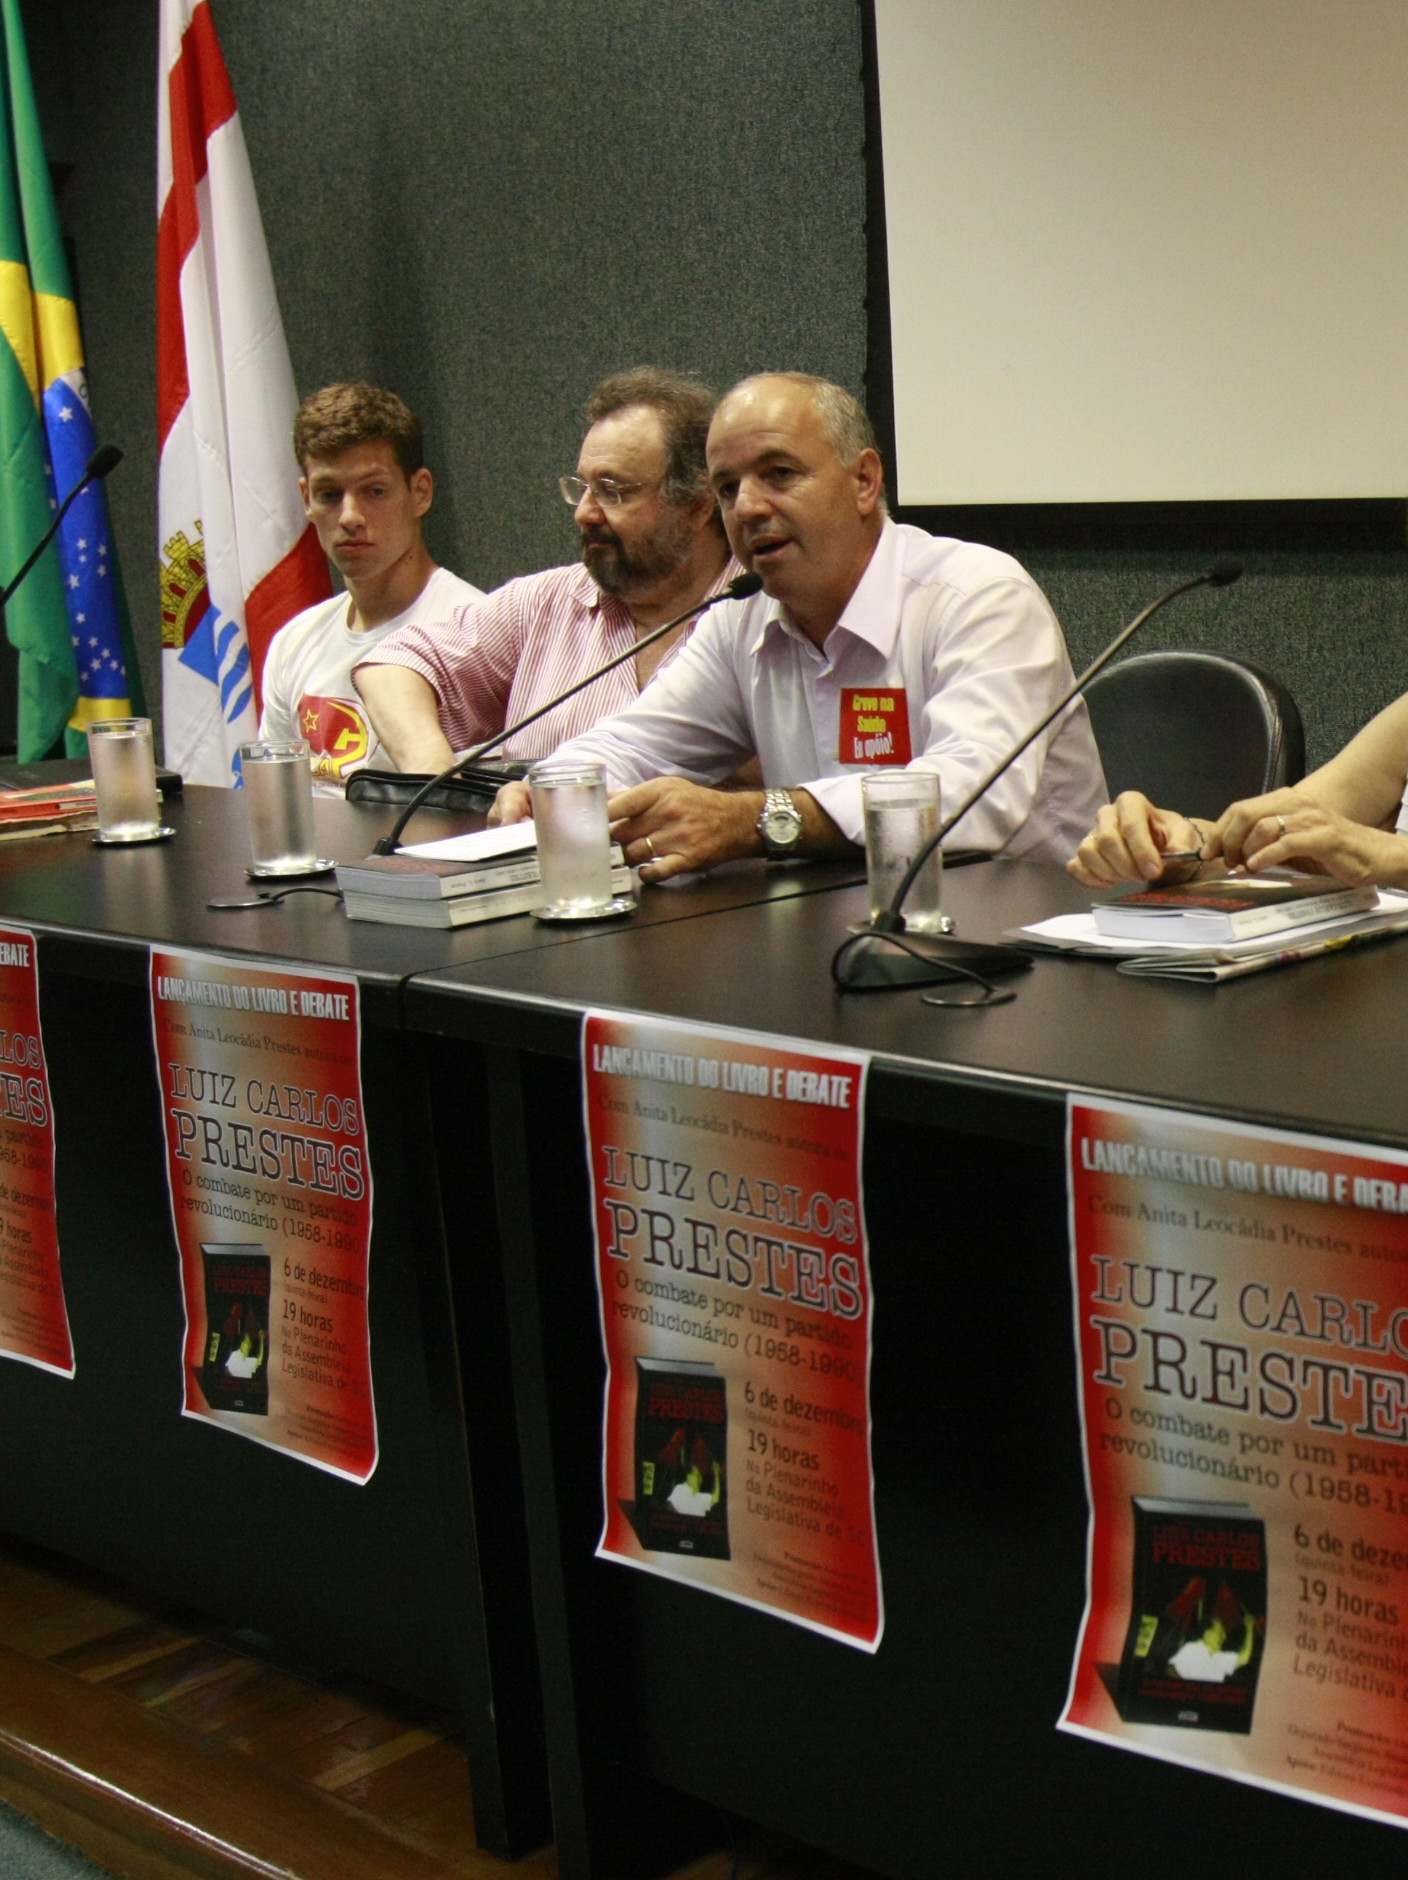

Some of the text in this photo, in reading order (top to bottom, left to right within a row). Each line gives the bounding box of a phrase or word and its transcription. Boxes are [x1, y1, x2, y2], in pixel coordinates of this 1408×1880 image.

[880, 697, 895, 712] na
[158, 976, 350, 1021] LANÇAMENTO DO LIVRO E DEBATE
[168, 1063, 360, 1136] LUIZ CARLOS
[592, 1044, 852, 1109] LANÇAMENTO DO LIVRO E DEBATE
[171, 1108, 365, 1200] PRESTES
[1081, 1136, 1224, 1188] LANÇAMENTO
[1227, 1158, 1259, 1193] DO
[1263, 1164, 1329, 1201] LIVRO
[1334, 1173, 1348, 1204] E
[196, 1174, 251, 1200] combate
[254, 1189, 278, 1206] por
[281, 1195, 305, 1213] um
[603, 1146, 858, 1244] LUIZ CARLOS
[1138, 1198, 1188, 1228] Anita
[1193, 1208, 1276, 1243] Leocádia
[1281, 1222, 1354, 1255] Prestes
[604, 1198, 863, 1321] PRESTES
[634, 1276, 708, 1310] combate
[712, 1295, 744, 1319] por
[748, 1308, 779, 1330] um
[1090, 1254, 1218, 1322] LUIZ
[283, 1299, 334, 1333] 19 horas
[613, 1300, 739, 1349] revolucionário
[745, 1381, 755, 1404] 6
[760, 1387, 778, 1411] de
[748, 1429, 821, 1471] 19 horas
[1104, 1398, 1123, 1420] O
[1129, 1406, 1230, 1447] combate
[1238, 1430, 1284, 1456] por
[1291, 1441, 1337, 1467] um
[1100, 1431, 1280, 1489] revolucionário
[1294, 1522, 1310, 1549] 6
[1317, 1528, 1344, 1557] de
[1299, 1575, 1399, 1626] 19 horas
[1295, 1632, 1318, 1652] da
[1293, 1653, 1396, 1699] Legislativa
